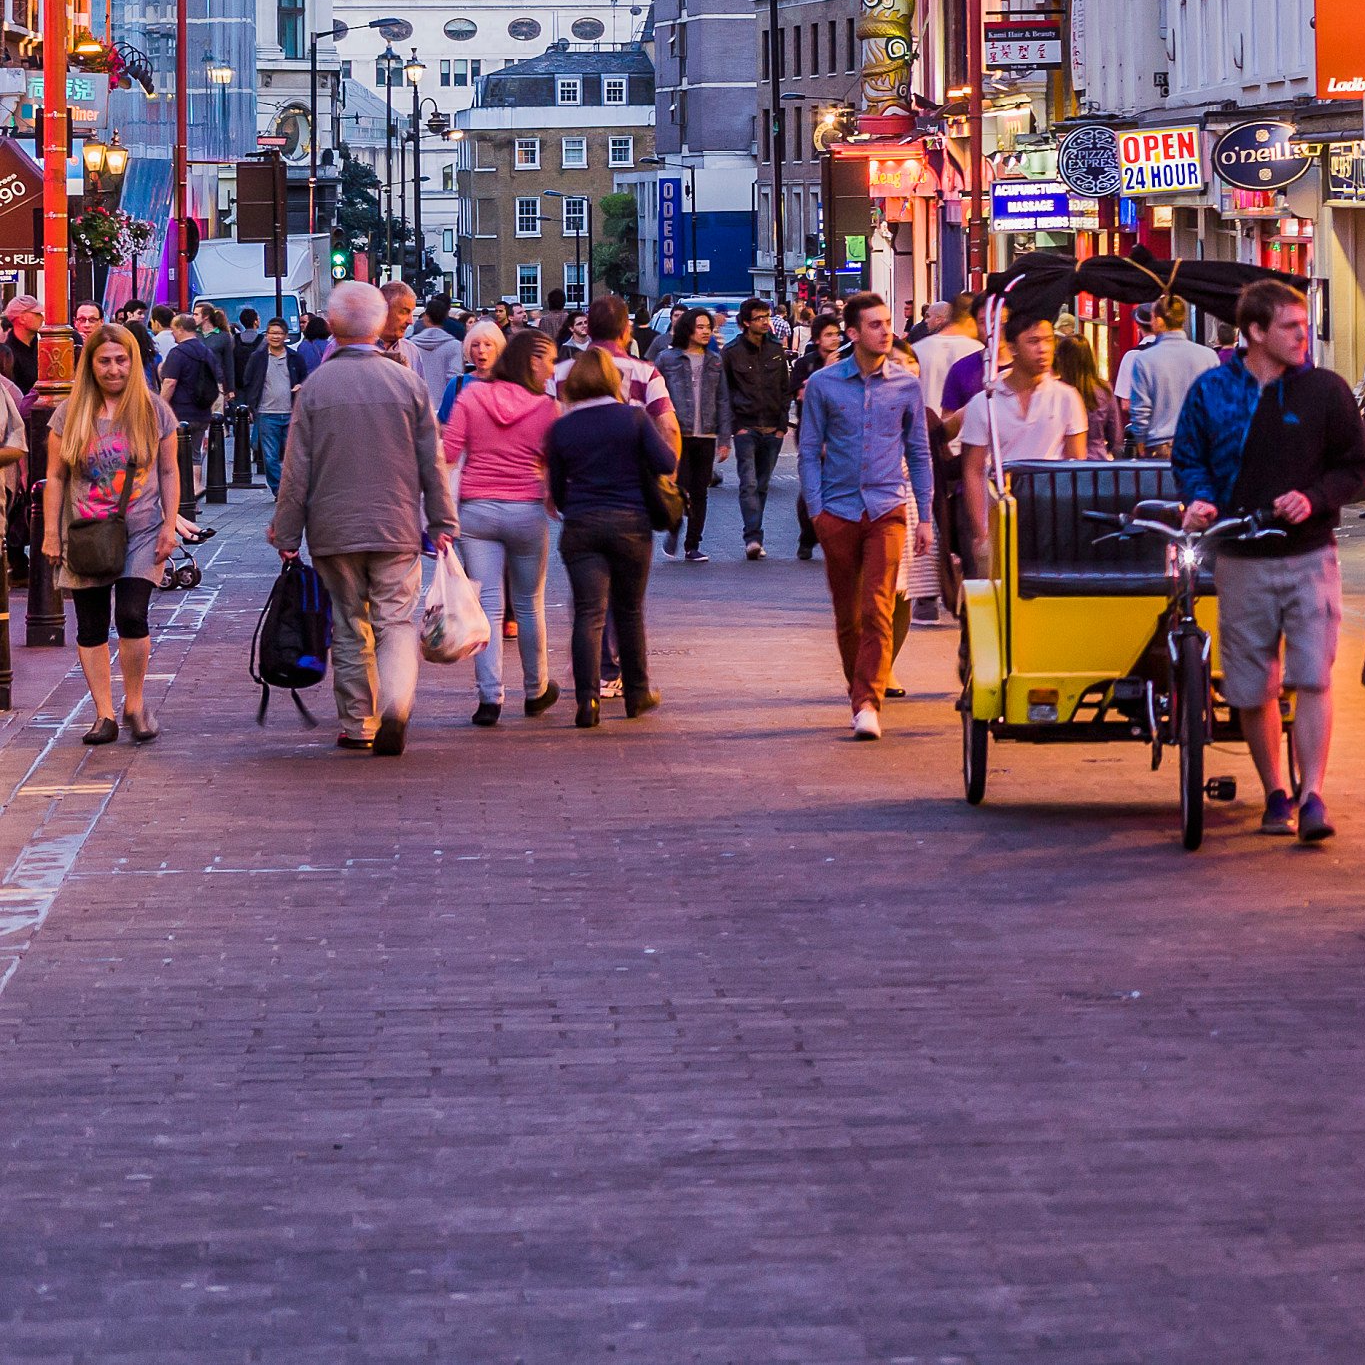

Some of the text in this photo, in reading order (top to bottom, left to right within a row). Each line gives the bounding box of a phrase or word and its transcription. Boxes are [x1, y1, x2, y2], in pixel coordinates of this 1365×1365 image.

[1078, 150, 1113, 161] PIZZA
[1122, 131, 1196, 165] OPEN
[1124, 161, 1199, 191] 24 HOUR
[663, 182, 675, 275] ODEON
